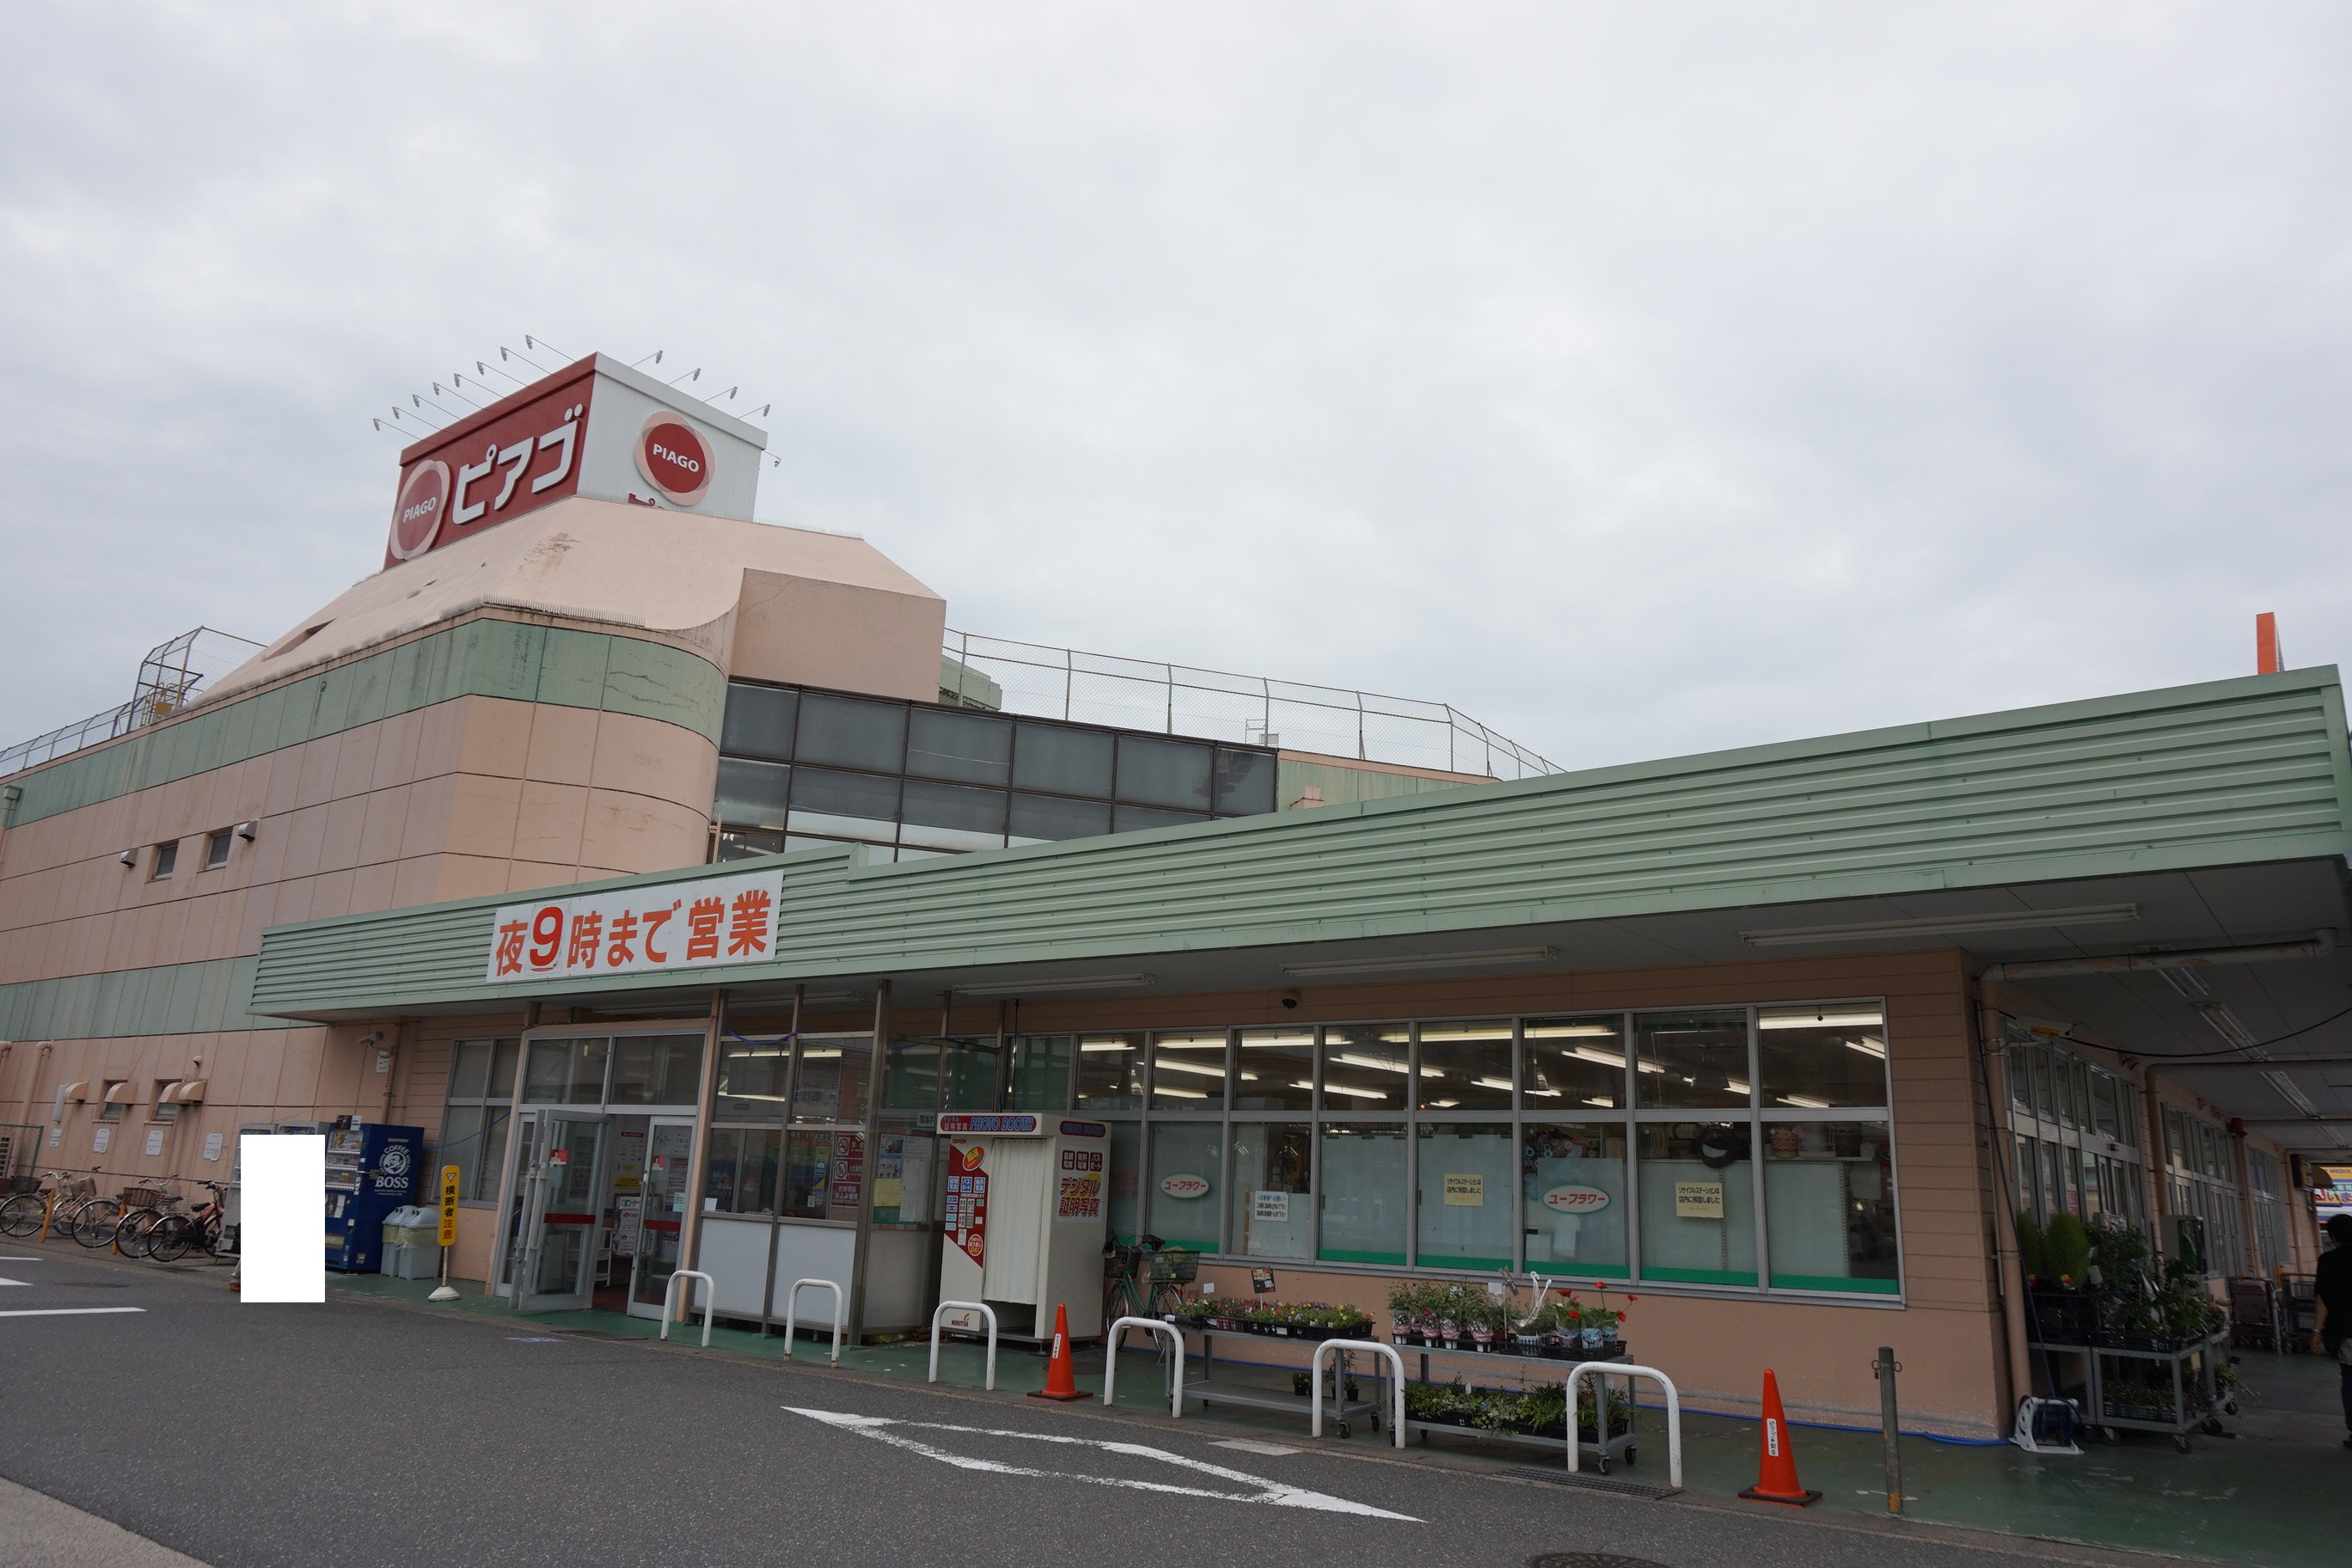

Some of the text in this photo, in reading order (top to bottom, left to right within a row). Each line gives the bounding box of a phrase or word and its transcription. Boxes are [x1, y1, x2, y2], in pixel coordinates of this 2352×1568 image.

[452, 403, 584, 524] ピアゴ
[652, 443, 700, 473] PIAGO
[402, 496, 437, 523] PIAGO
[495, 889, 772, 977] 夜9時まで営業
[969, 1117, 1034, 1131] PHOTO BOOTH
[383, 1144, 410, 1155] COFFEE
[374, 1176, 409, 1190] BOSS
[1060, 1177, 1100, 1197] デジタル
[1164, 1180, 1206, 1191] ユーフラワー
[1058, 1197, 1100, 1217] 証明写真
[1547, 1193, 1606, 1204] ユーフラワー
[442, 1185, 456, 1240] 横断者注意
